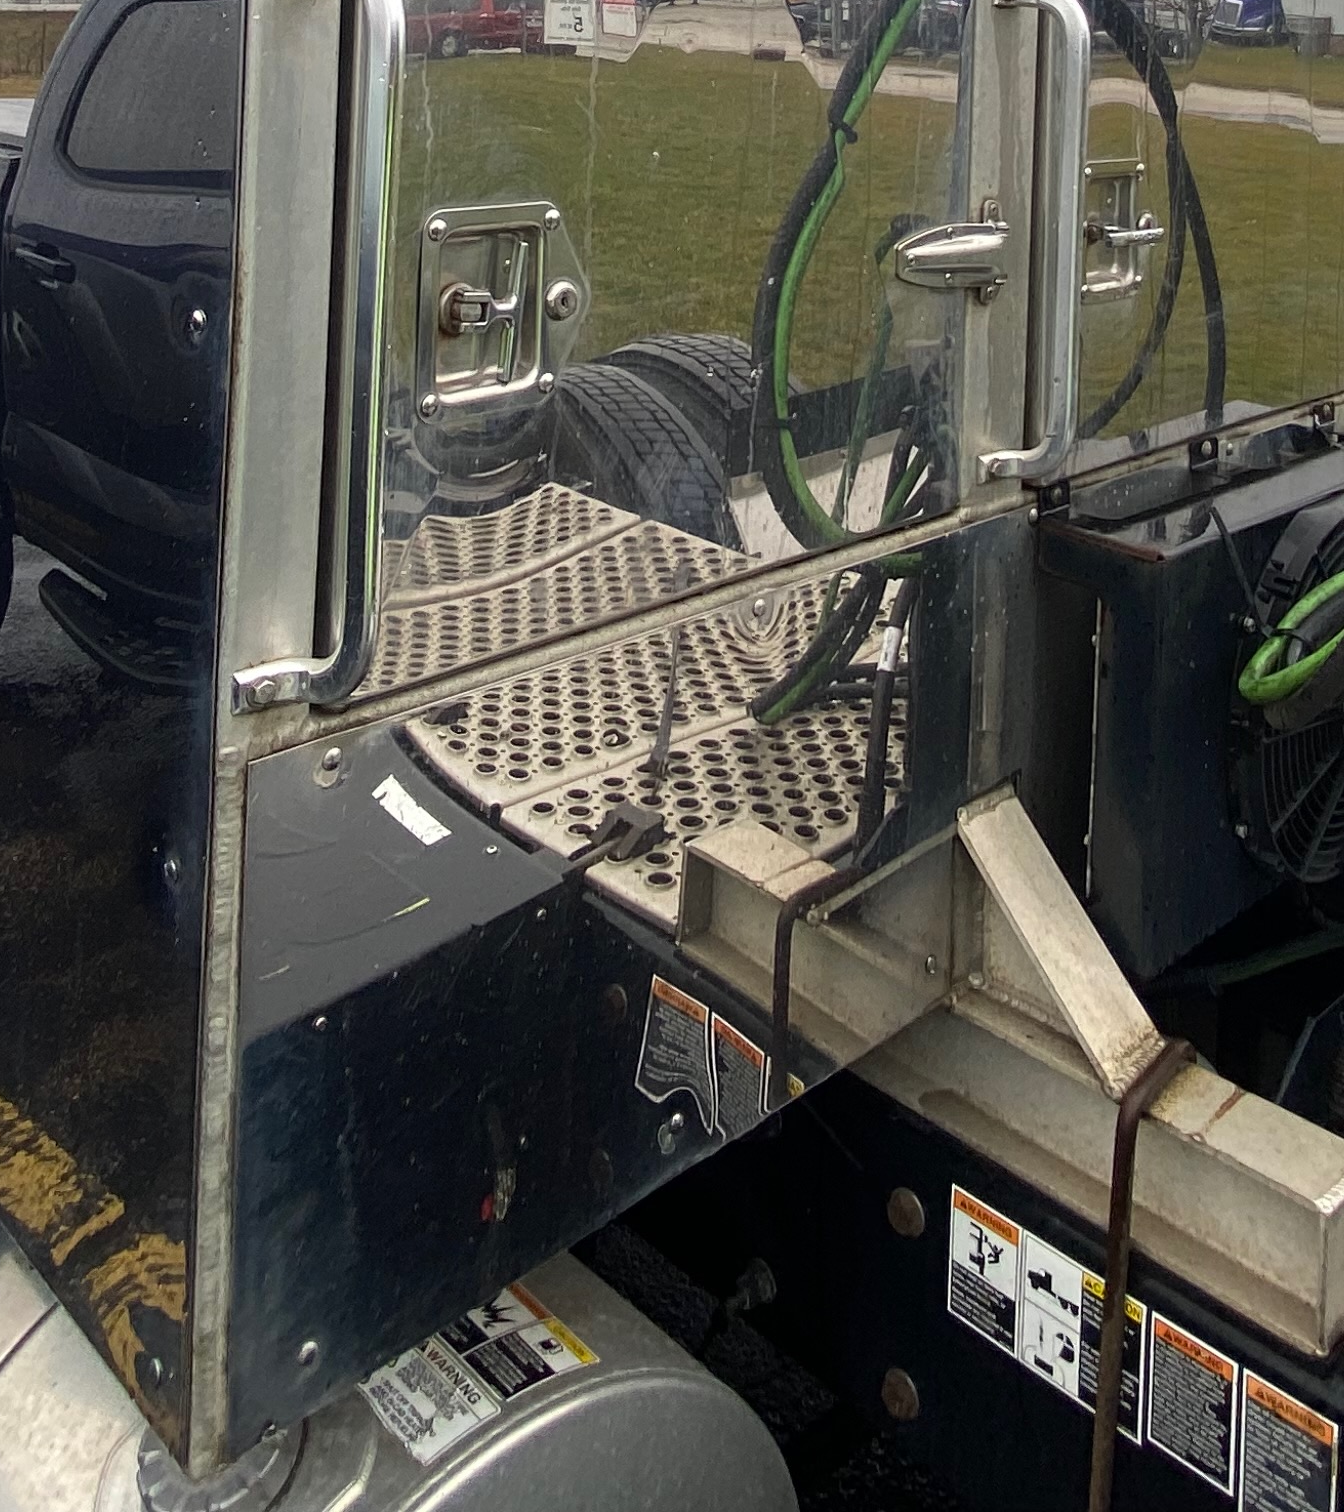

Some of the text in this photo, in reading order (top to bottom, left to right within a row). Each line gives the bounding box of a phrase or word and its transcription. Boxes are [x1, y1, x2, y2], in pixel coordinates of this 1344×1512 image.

[966, 1201, 1013, 1239] WARNING
[426, 1348, 482, 1406] WARNING
[1265, 1389, 1326, 1438] WARNING
